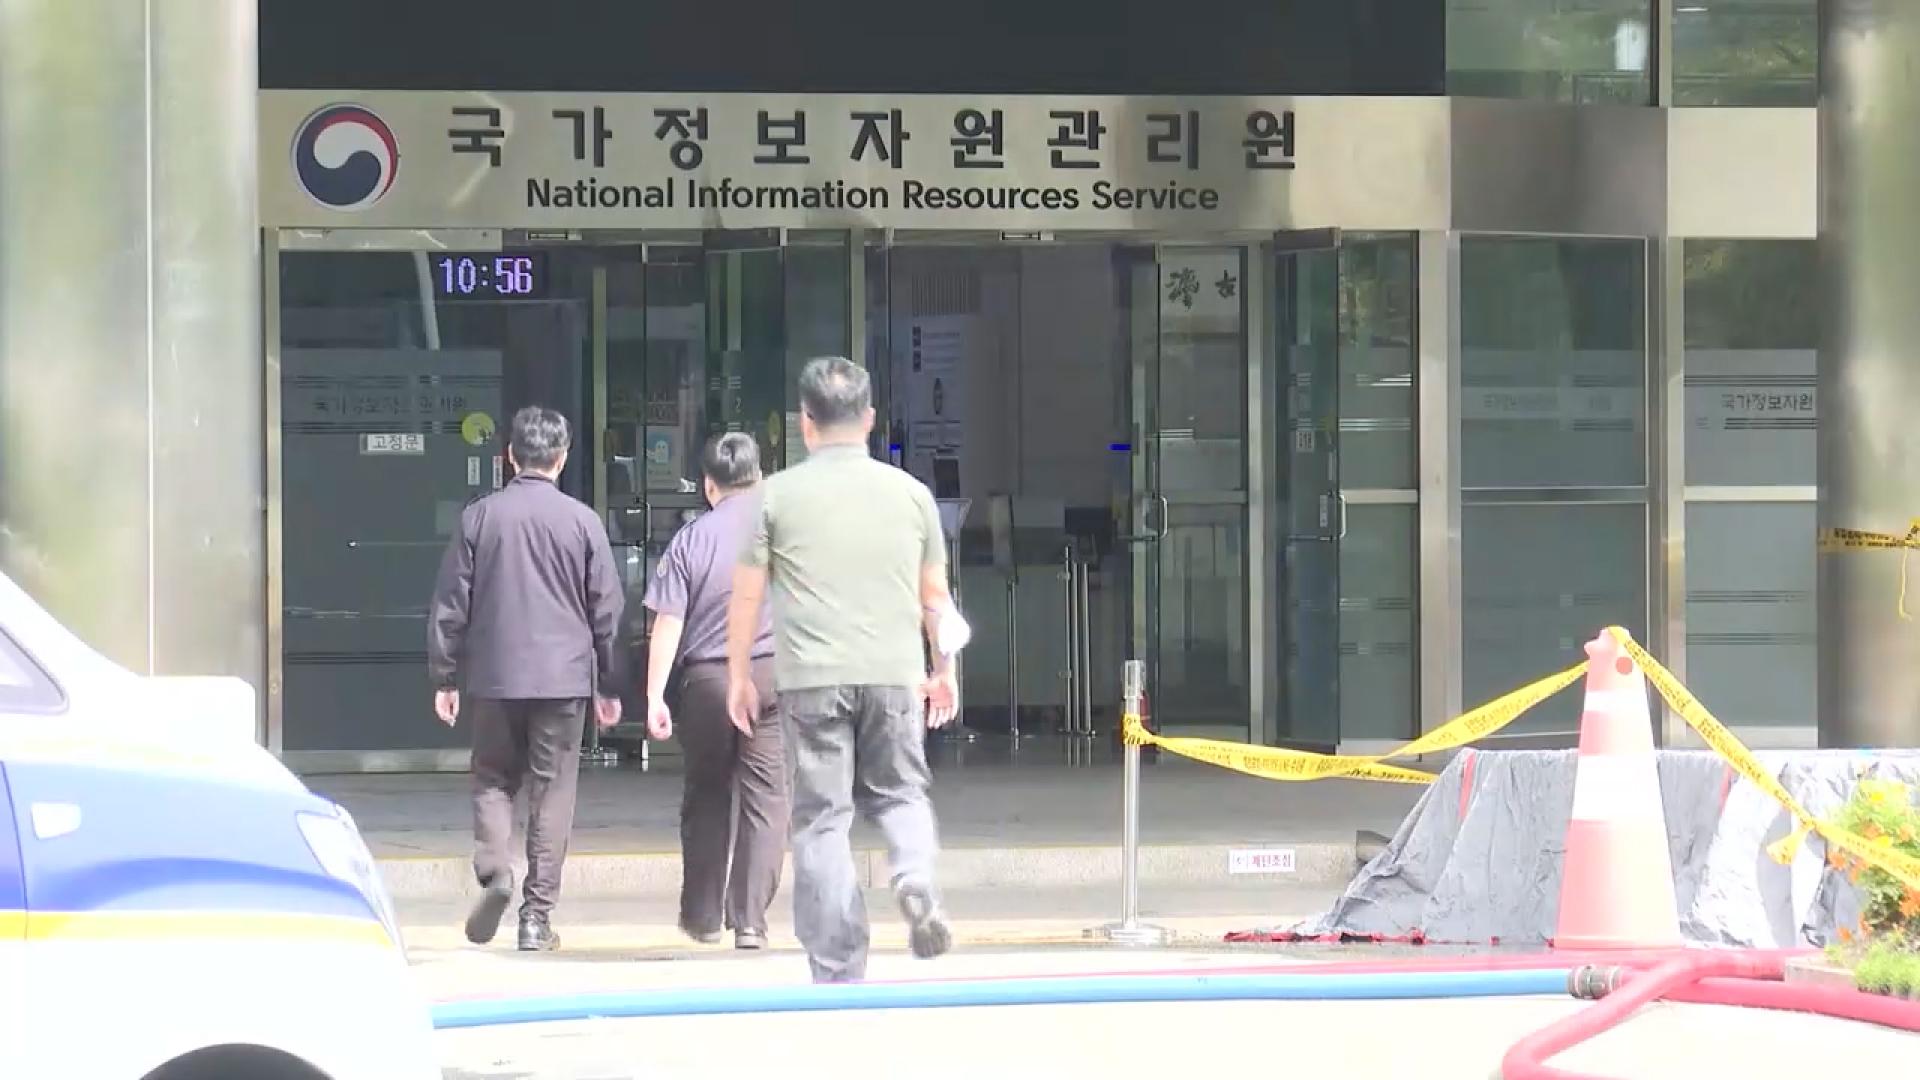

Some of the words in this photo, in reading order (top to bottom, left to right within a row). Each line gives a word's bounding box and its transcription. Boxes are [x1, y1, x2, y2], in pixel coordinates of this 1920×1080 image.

[448, 107, 1296, 170] 국가정보자원관리원
[527, 178, 673, 209] National
[688, 178, 888, 209] Information
[903, 179, 1079, 210] Resources
[1092, 179, 1219, 210] Service
[439, 257, 533, 294] 10:56
[373, 436, 419, 452] 고정문
